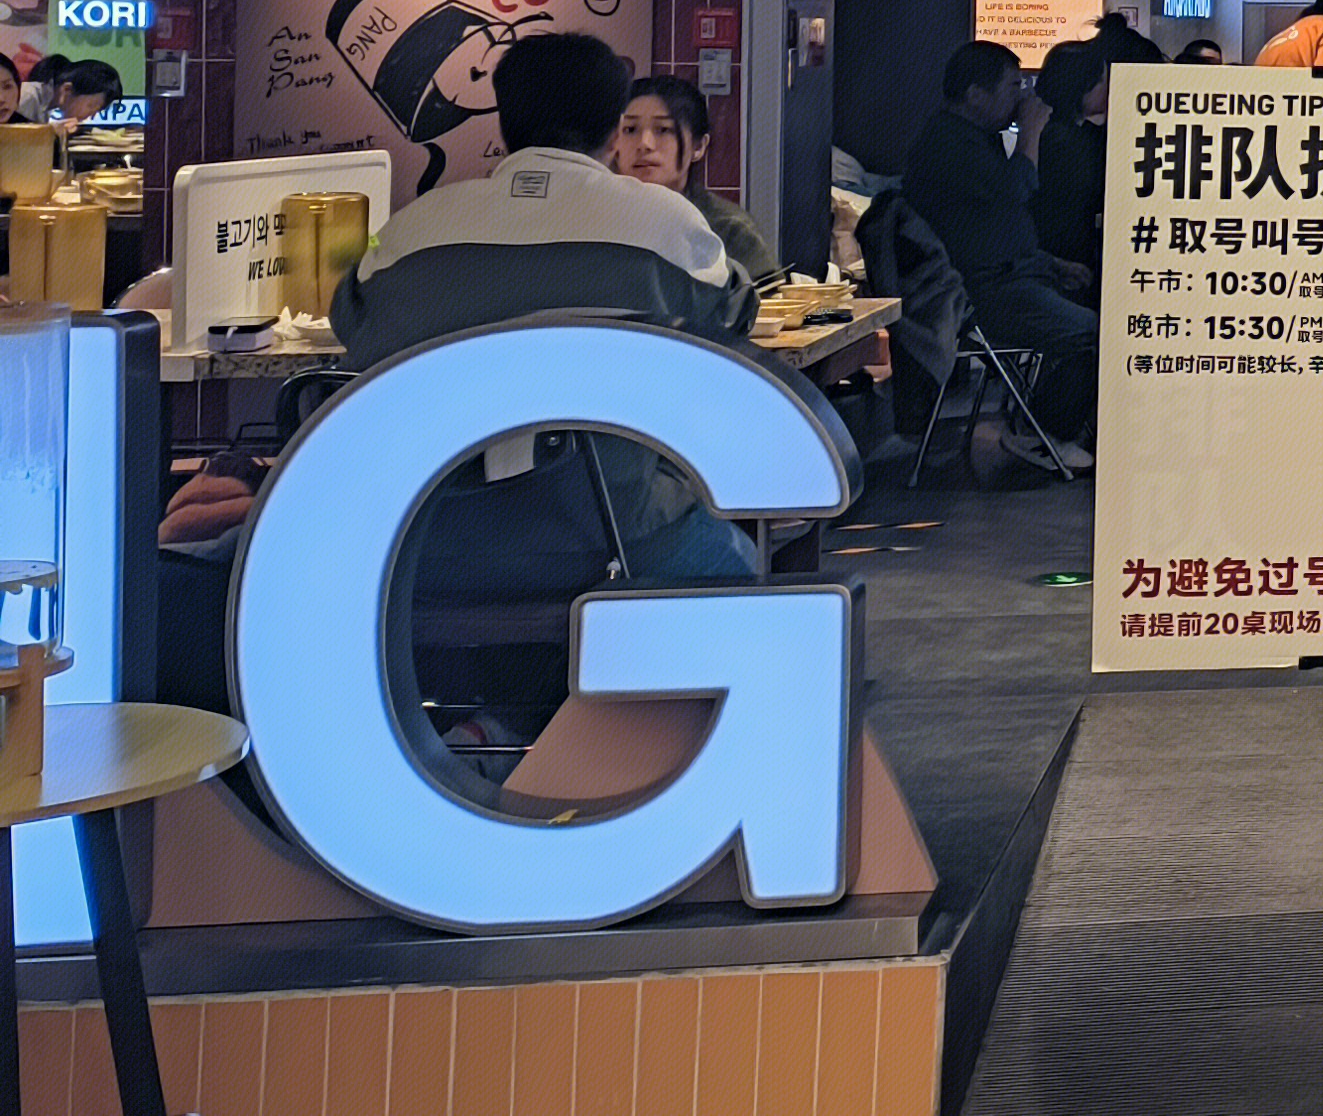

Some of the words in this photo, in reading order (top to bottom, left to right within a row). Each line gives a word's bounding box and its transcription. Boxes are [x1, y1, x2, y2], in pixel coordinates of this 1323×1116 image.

[266, 25, 312, 47] An
[345, 6, 398, 61] PANG
[268, 49, 322, 72] San
[265, 71, 336, 99] Pang
[1136, 91, 1275, 116] QUEUEING
[215, 213, 269, 254] 불고기와
[248, 259, 264, 281] WE
[1299, 316, 1323, 329] PM
[226, 311, 860, 934] G
